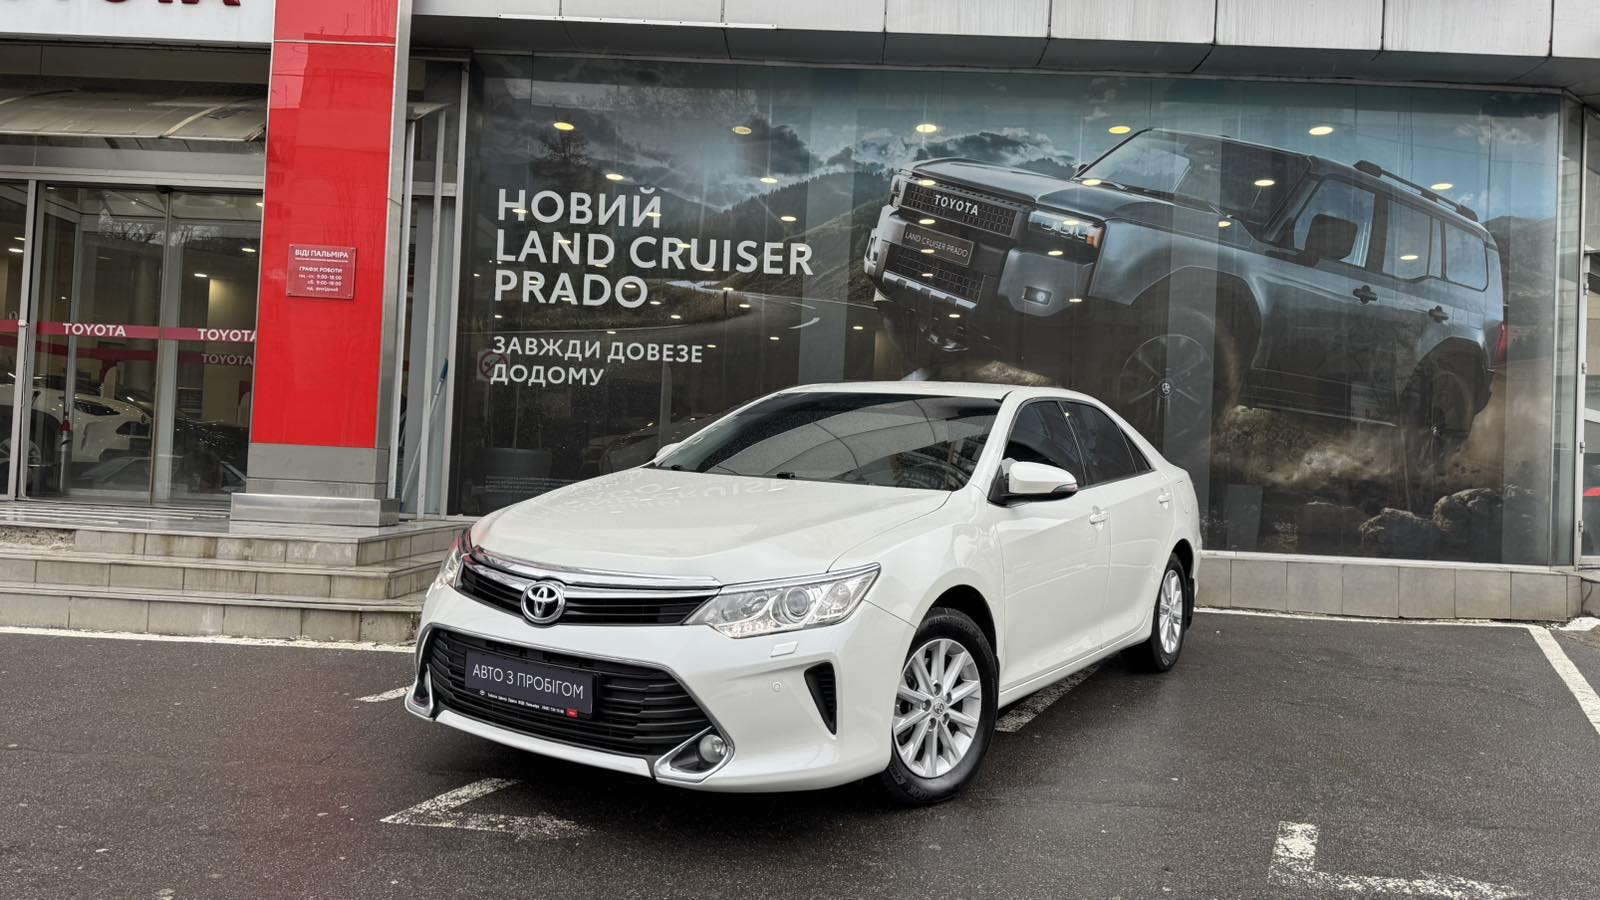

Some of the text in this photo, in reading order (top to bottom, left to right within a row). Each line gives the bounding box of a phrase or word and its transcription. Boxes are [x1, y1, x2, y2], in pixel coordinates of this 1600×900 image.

[498, 187, 662, 228] НОВИЙ
[935, 194, 978, 216] TOYOTA
[295, 249, 349, 258] ВІДІ ПАЛЬМІРА
[496, 229, 814, 276] LAND CRUISER
[494, 269, 649, 309] PRADO
[62, 322, 127, 337] TOYOTA
[201, 353, 254, 366] TOYOTA
[492, 336, 703, 364] ЗАВЖДИ ДОВЕЗЕ
[490, 364, 604, 387] ДОДОМУ
[472, 663, 504, 682] АВТО
[517, 672, 584, 700] ПРОБІГОМ
